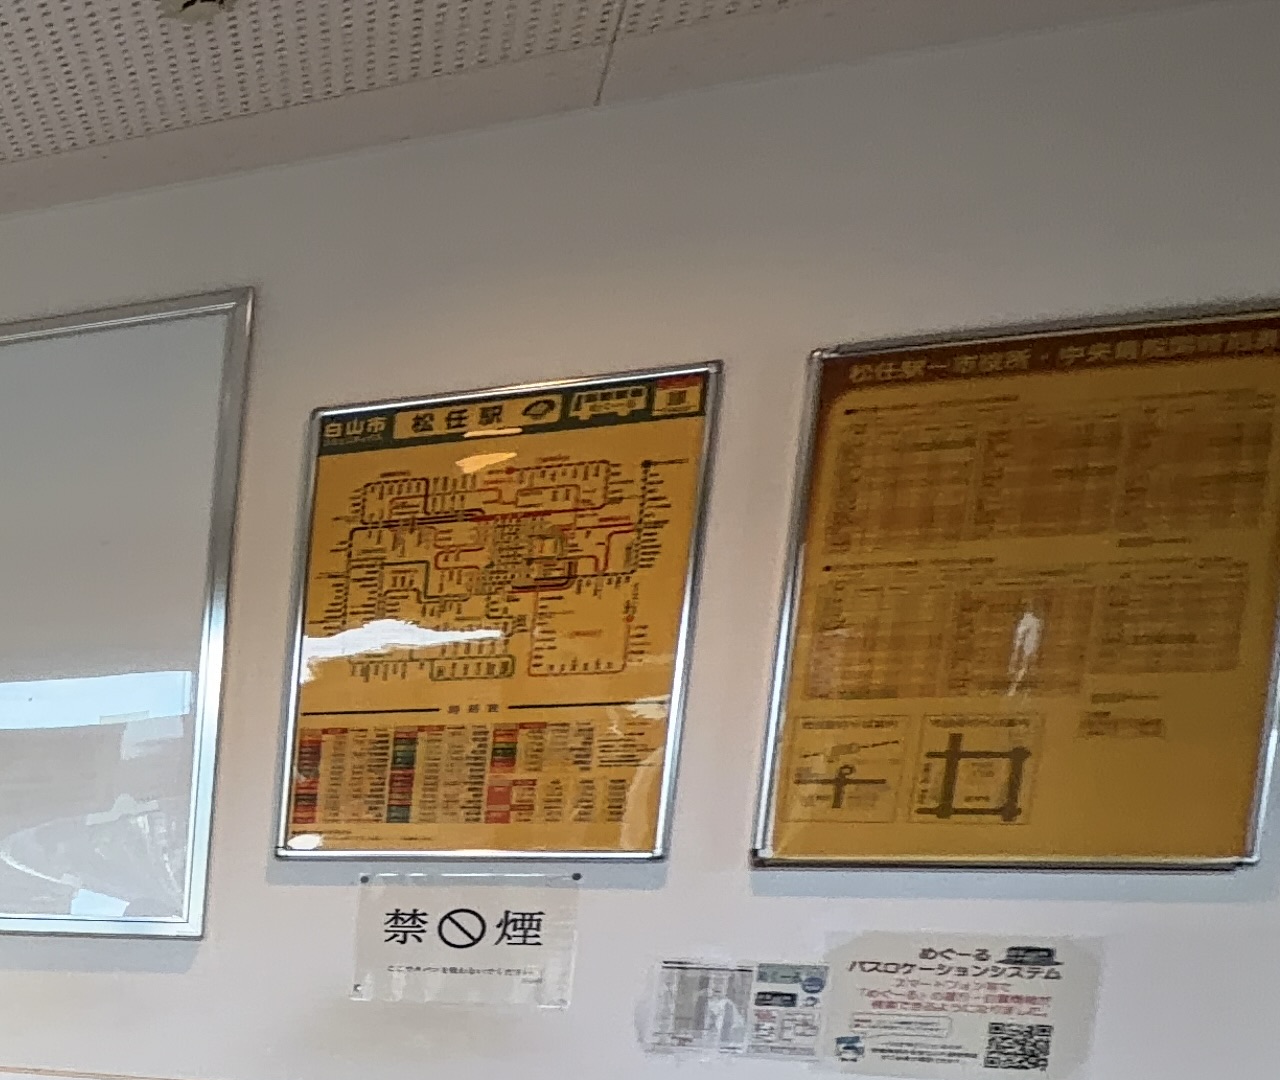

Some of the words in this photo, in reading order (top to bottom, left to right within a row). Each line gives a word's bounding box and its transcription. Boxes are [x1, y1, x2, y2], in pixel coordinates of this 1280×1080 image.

[324, 416, 388, 438] 白山市
[411, 405, 503, 433] 松任駅
[383, 908, 429, 945] 禁
[494, 910, 546, 946] 煙
[919, 948, 991, 961] めぐーる
[848, 961, 1062, 980] バスロケーションシステム
